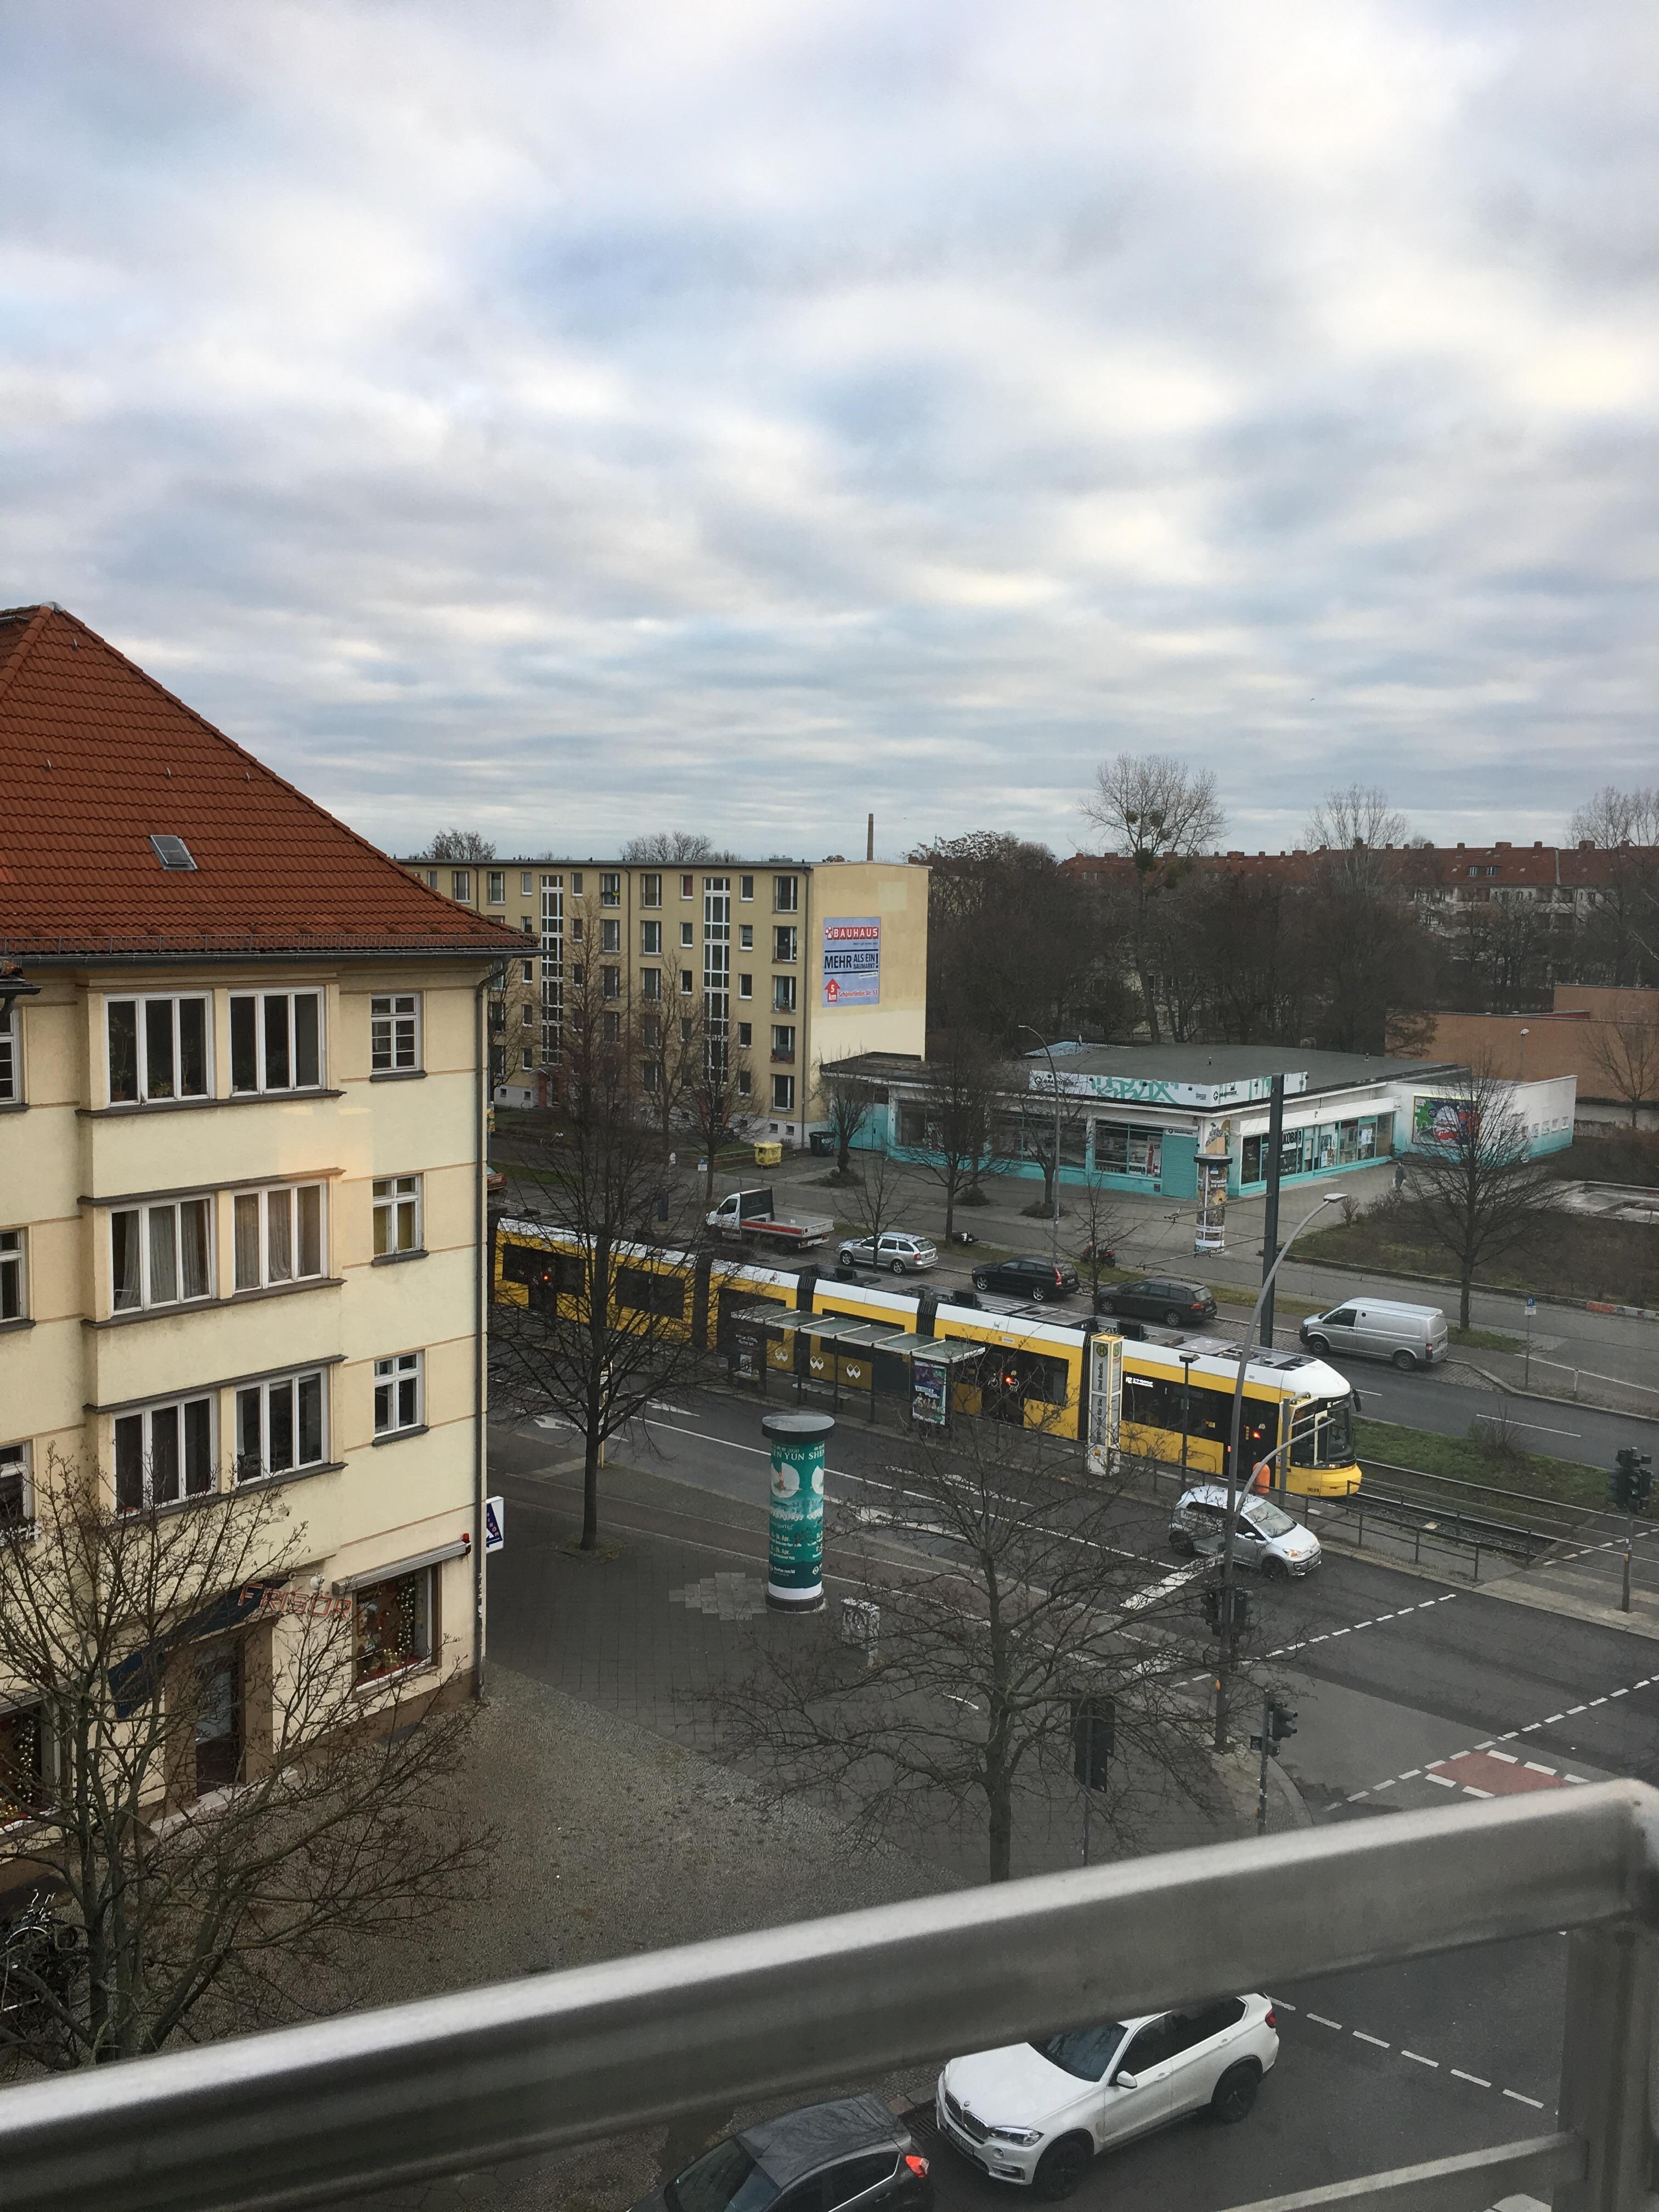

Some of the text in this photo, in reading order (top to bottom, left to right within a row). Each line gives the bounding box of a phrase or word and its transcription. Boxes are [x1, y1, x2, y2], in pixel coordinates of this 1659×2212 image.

[833, 928, 878, 938] BAUHAUS
[825, 953, 875, 969] MEHR ALS EIN
[831, 984, 834, 992] 5
[238, 1583, 352, 1620] FRISÖR
